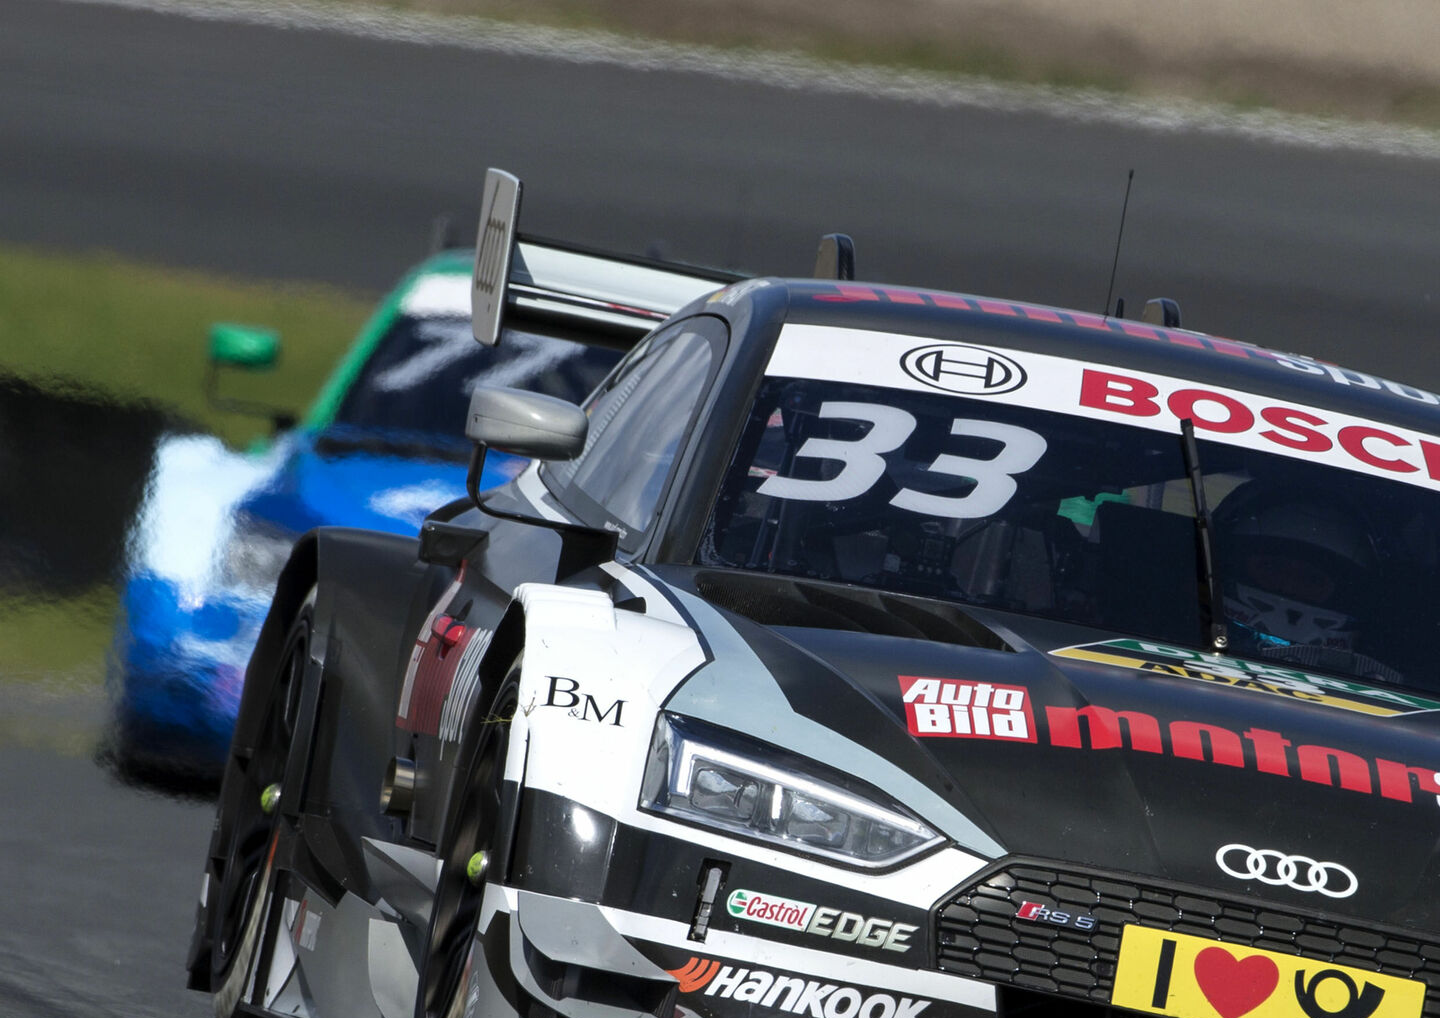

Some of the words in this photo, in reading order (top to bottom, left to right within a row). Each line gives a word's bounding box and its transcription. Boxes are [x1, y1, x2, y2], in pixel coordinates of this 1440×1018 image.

[756, 400, 1048, 520] 33
[902, 678, 1025, 711] Auto
[1137, 641, 1420, 706] DEKRA
[1139, 661, 1325, 702] ADAC
[1182, 659, 1326, 695] 33
[914, 702, 1029, 739] Bild
[745, 895, 808, 928] Castrol
[805, 905, 920, 953] EDGE
[1151, 938, 1177, 1009] I
